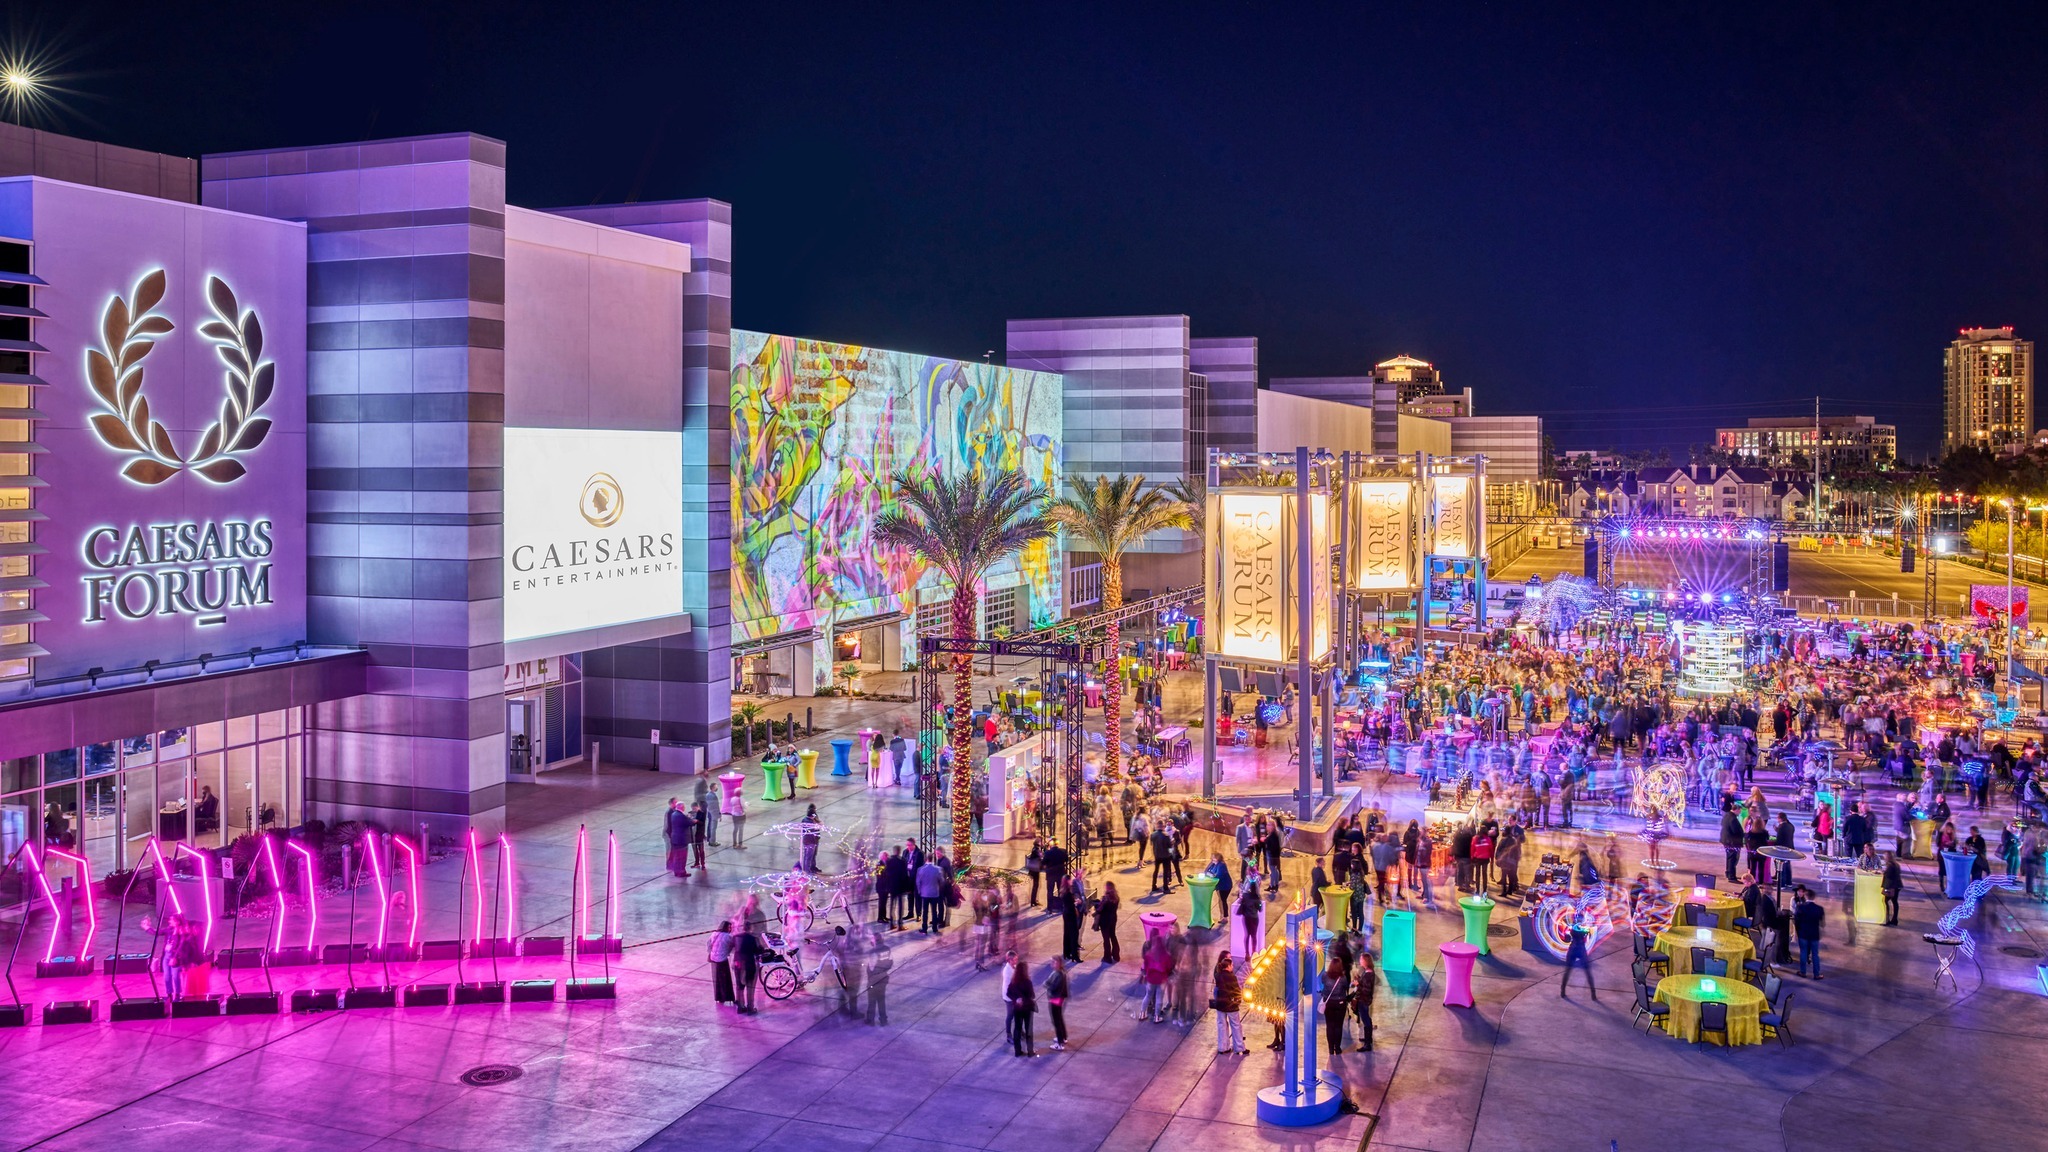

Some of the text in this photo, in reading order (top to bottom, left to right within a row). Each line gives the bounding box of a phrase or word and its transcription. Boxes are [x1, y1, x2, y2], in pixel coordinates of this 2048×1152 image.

[83, 520, 273, 568] CAESARS
[511, 532, 673, 571] CAESARS
[1386, 492, 1402, 578] CAESARS
[83, 563, 273, 622] FORUM
[1255, 511, 1273, 643] CAESARS
